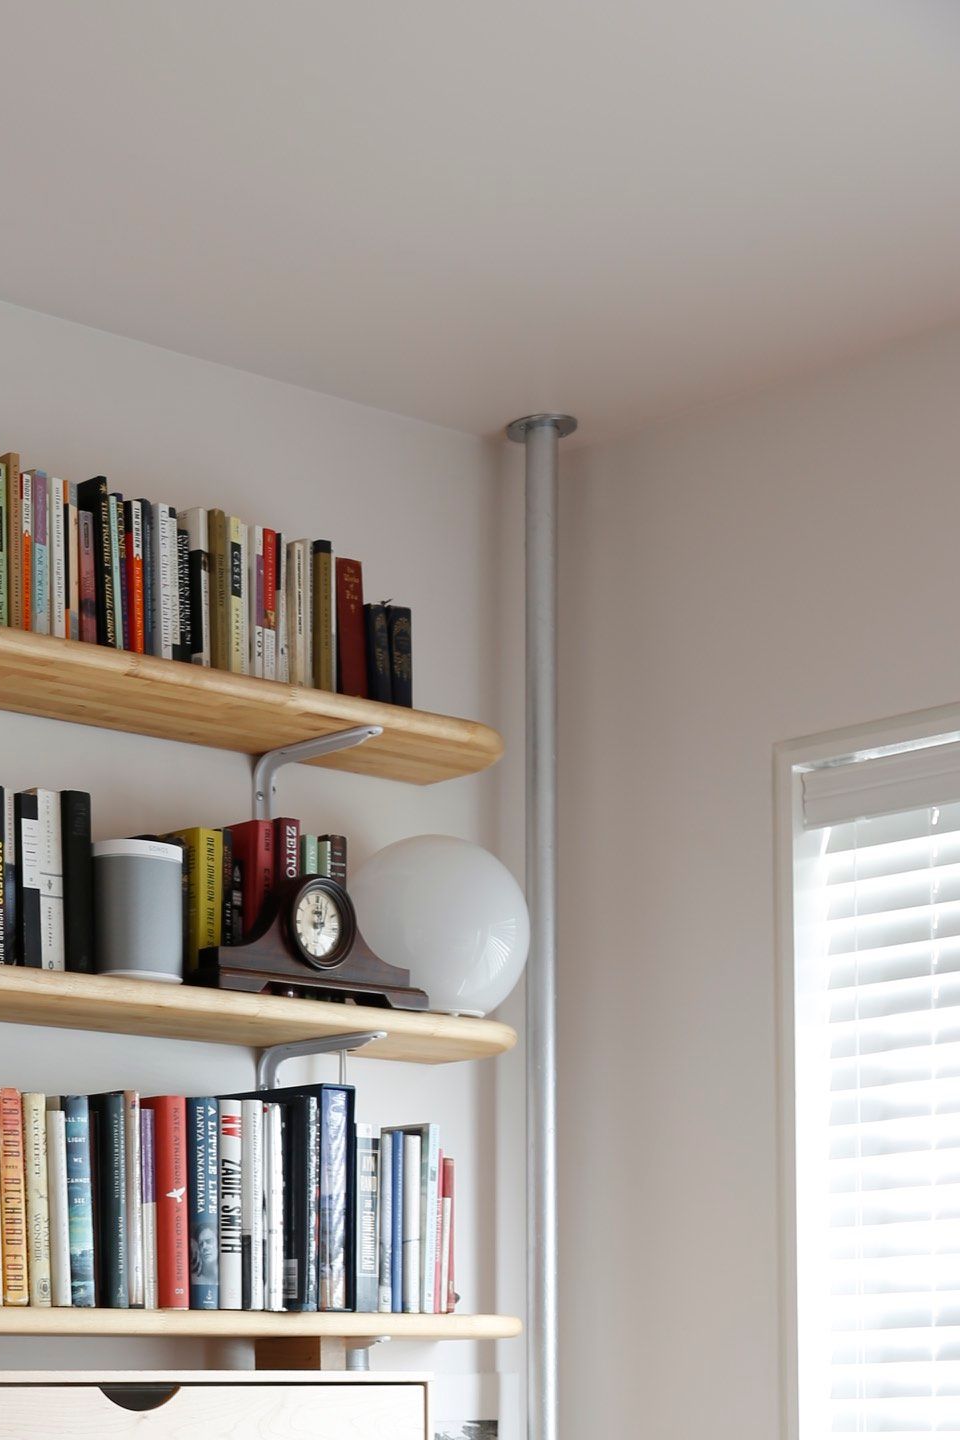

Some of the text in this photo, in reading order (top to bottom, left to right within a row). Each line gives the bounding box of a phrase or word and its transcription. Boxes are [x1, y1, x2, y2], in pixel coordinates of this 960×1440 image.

[36, 548, 44, 566] FAR
[117, 502, 126, 558] FICCIONES
[36, 570, 44, 614] TORTUGA
[104, 574, 115, 644] KAHLIL GIBRAN
[160, 510, 170, 650] Choke Chuck Palahniuk
[206, 837, 215, 902] DENIS JOHNSON
[286, 826, 297, 878] ZEITO
[207, 907, 215, 938] TREE OF
[2, 1097, 20, 1158] CANADA
[32, 1108, 41, 1178] PATCHETT
[221, 1114, 242, 1140] NW
[196, 1106, 206, 1214] HANYA YANAGIHARA
[208, 1106, 218, 1214] A LITTLE LIFE
[4, 1178, 24, 1292] RICHARD FORD
[221, 1158, 242, 1254] ZADIE SMITH
[34, 1214, 42, 1263] WONDER
[176, 1238, 182, 1249] IN
[361, 1210, 375, 1270] FOUNTAINHEAD
